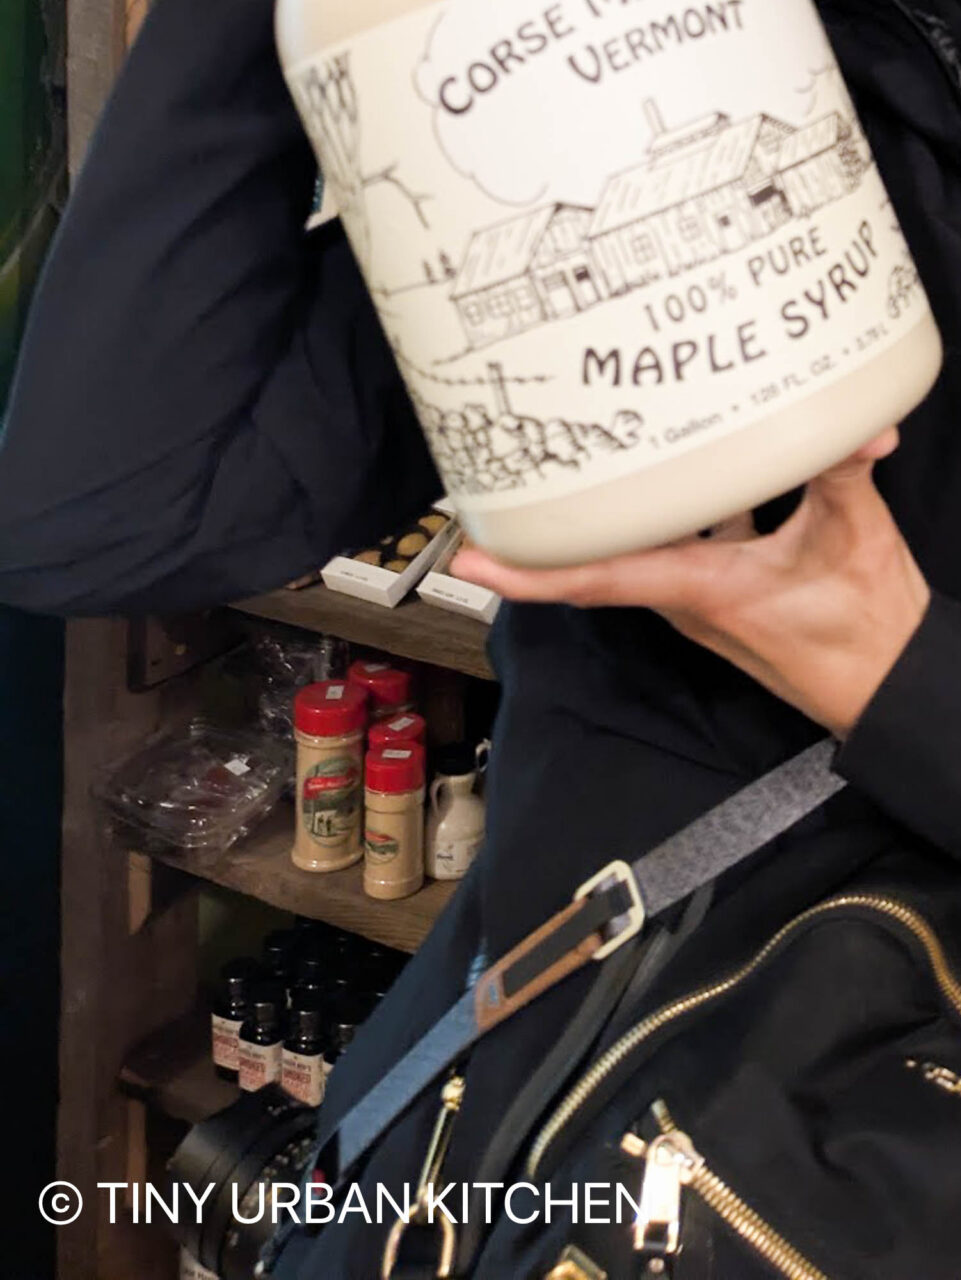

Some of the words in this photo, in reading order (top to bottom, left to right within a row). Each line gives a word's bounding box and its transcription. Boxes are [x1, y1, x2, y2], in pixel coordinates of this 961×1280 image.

[438, 3, 576, 116] CORSE
[581, 320, 767, 387] MAPLE
[780, 219, 878, 339] SYRUP
[643, 271, 738, 333] 100%
[747, 226, 827, 287] PURE
[663, 412, 724, 444] Gallon
